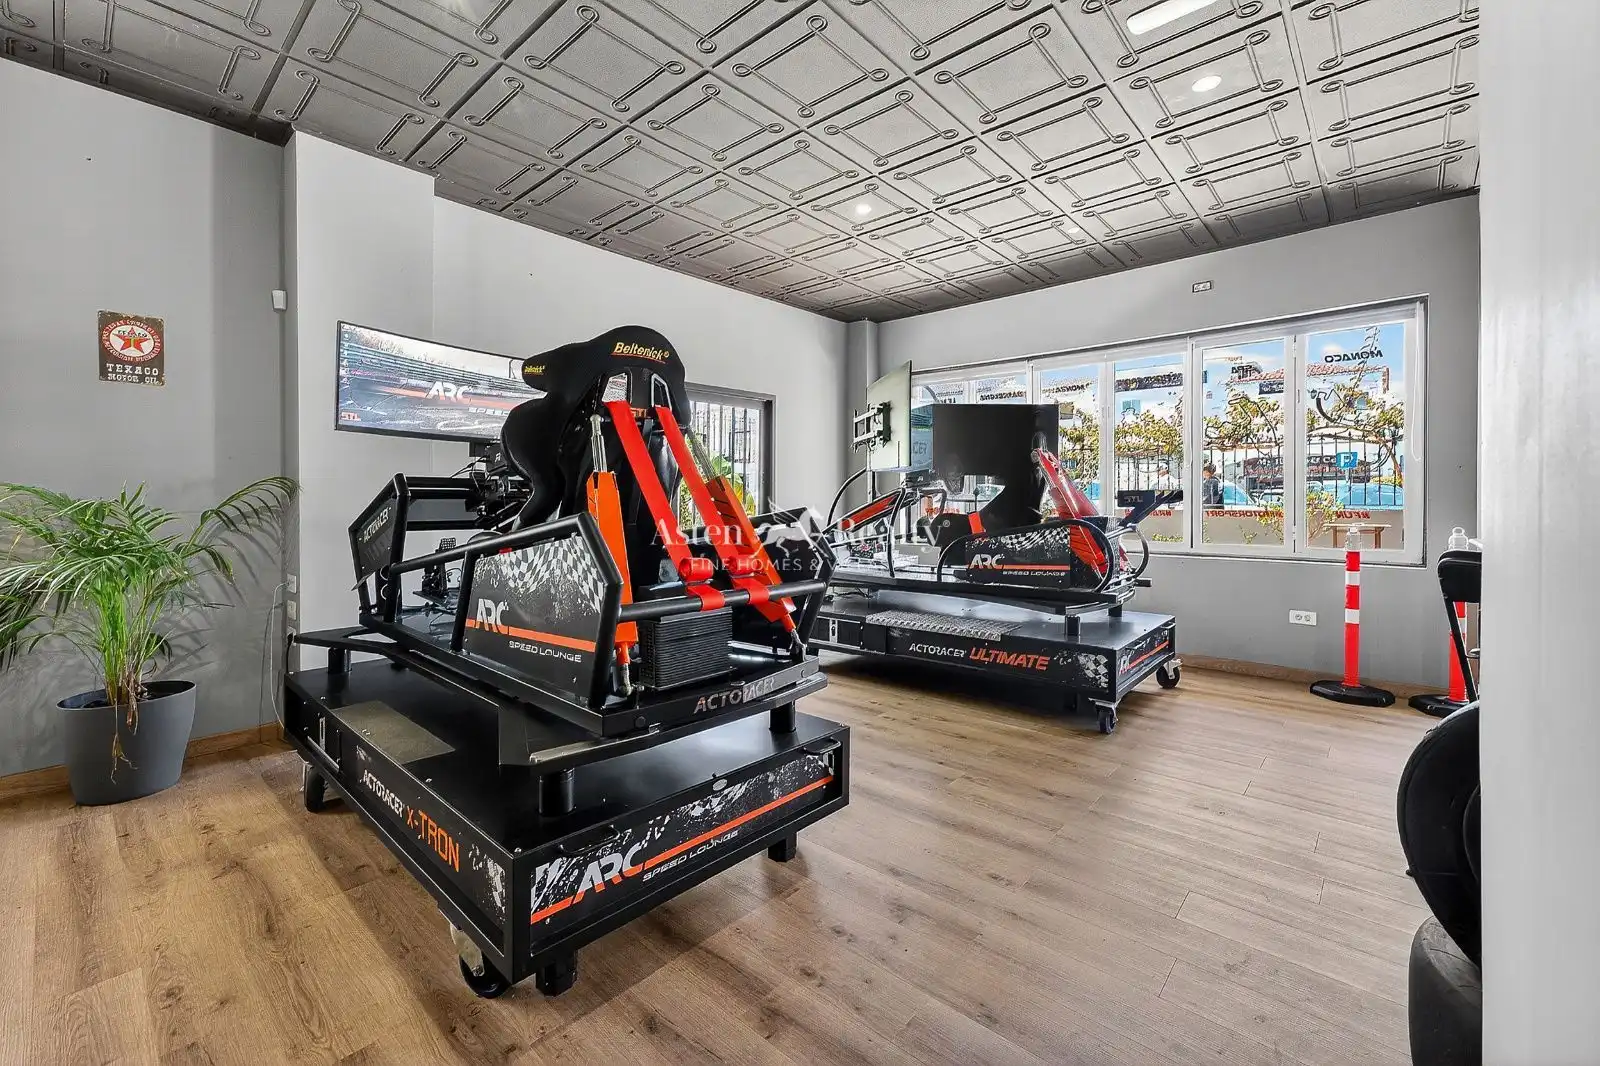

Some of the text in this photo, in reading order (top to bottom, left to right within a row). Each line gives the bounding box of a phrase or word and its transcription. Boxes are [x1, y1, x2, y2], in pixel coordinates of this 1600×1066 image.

[106, 363, 159, 376] TEXACO
[107, 373, 158, 385] MOTOR OIL
[427, 380, 472, 403] ARC
[968, 553, 1005, 570] ARC
[475, 598, 509, 635] ARC
[509, 640, 583, 664] SPEED LOUNGE
[908, 642, 1051, 672] ACTORACER ULTIMATE
[693, 676, 776, 715] ACTORACER
[362, 769, 460, 873] ACTORACER X-TRON
[642, 829, 740, 882] SPEED LOUNGE
[571, 839, 648, 905] ARC
